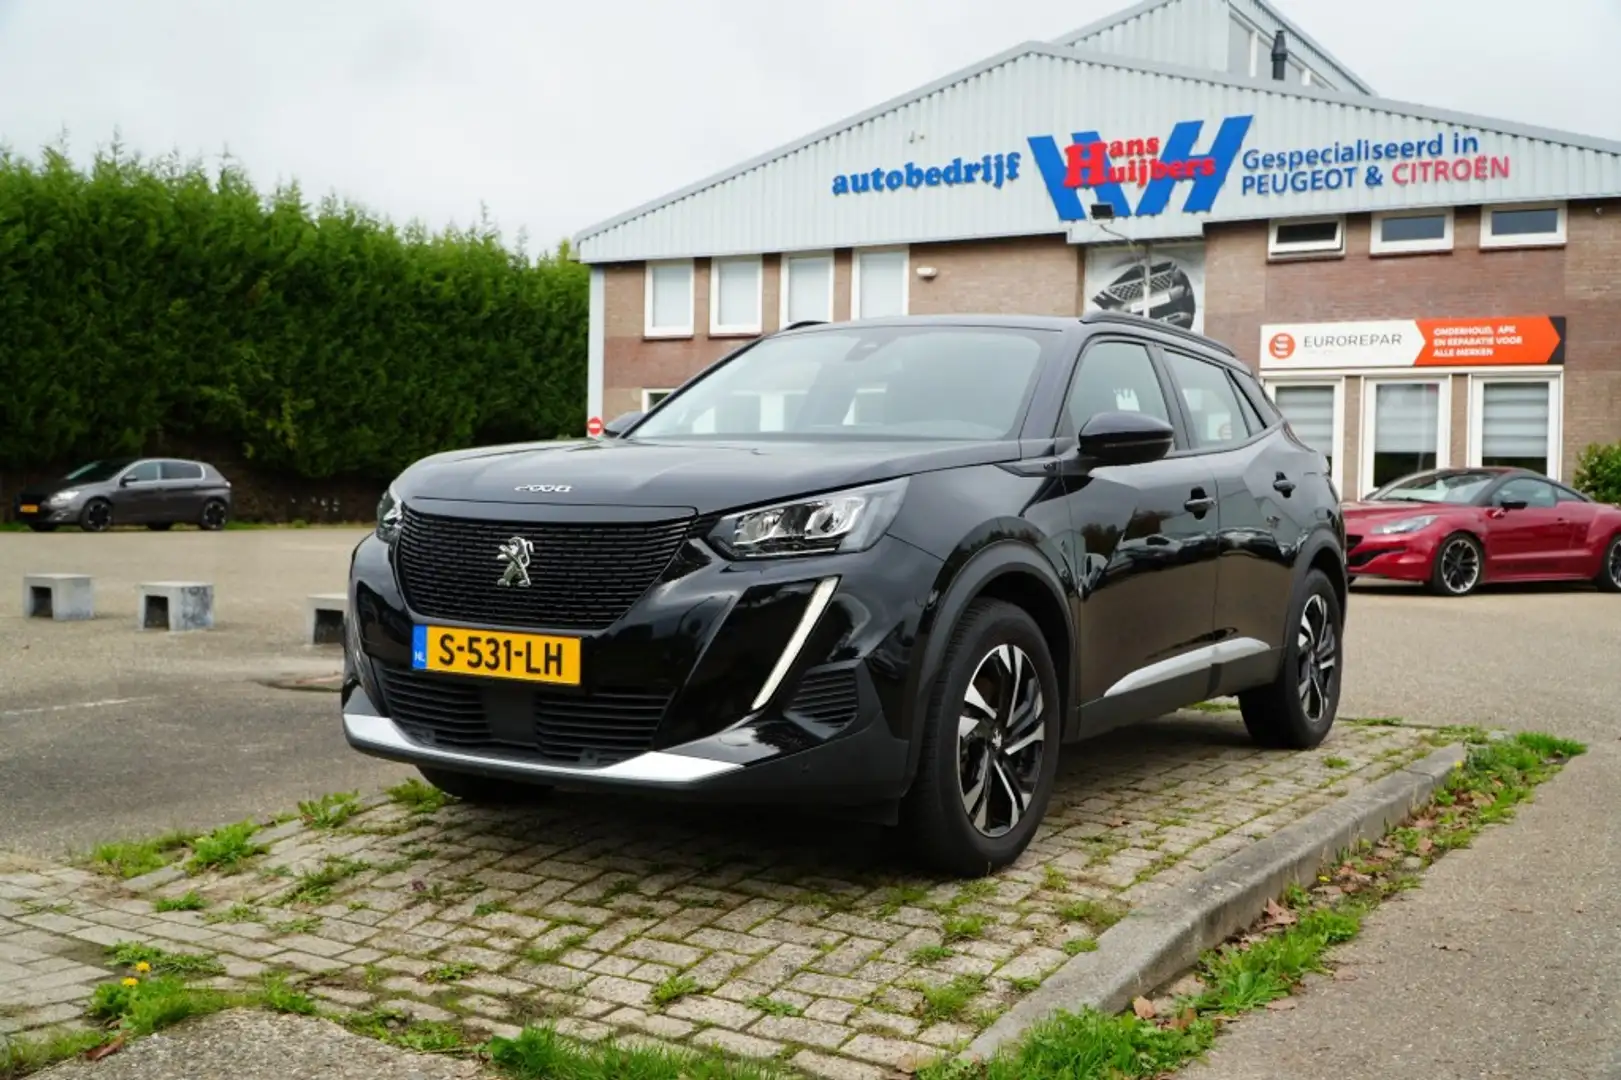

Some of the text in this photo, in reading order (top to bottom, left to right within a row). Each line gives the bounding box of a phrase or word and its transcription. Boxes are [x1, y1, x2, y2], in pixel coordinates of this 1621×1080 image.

[1063, 137, 1160, 188] Hans
[1242, 132, 1479, 172] Gespecialiseerd in
[832, 152, 1022, 196] autobedrijf
[1242, 155, 1510, 196] PEUGEOT & CITROËN
[1303, 333, 1403, 349] EUROREPAR
[1432, 335, 1523, 347] EN REPARATIE VOOR
[1432, 347, 1494, 358] ALLE MERKEN
[414, 650, 426, 662] NL
[438, 633, 563, 677] S-531-LH
